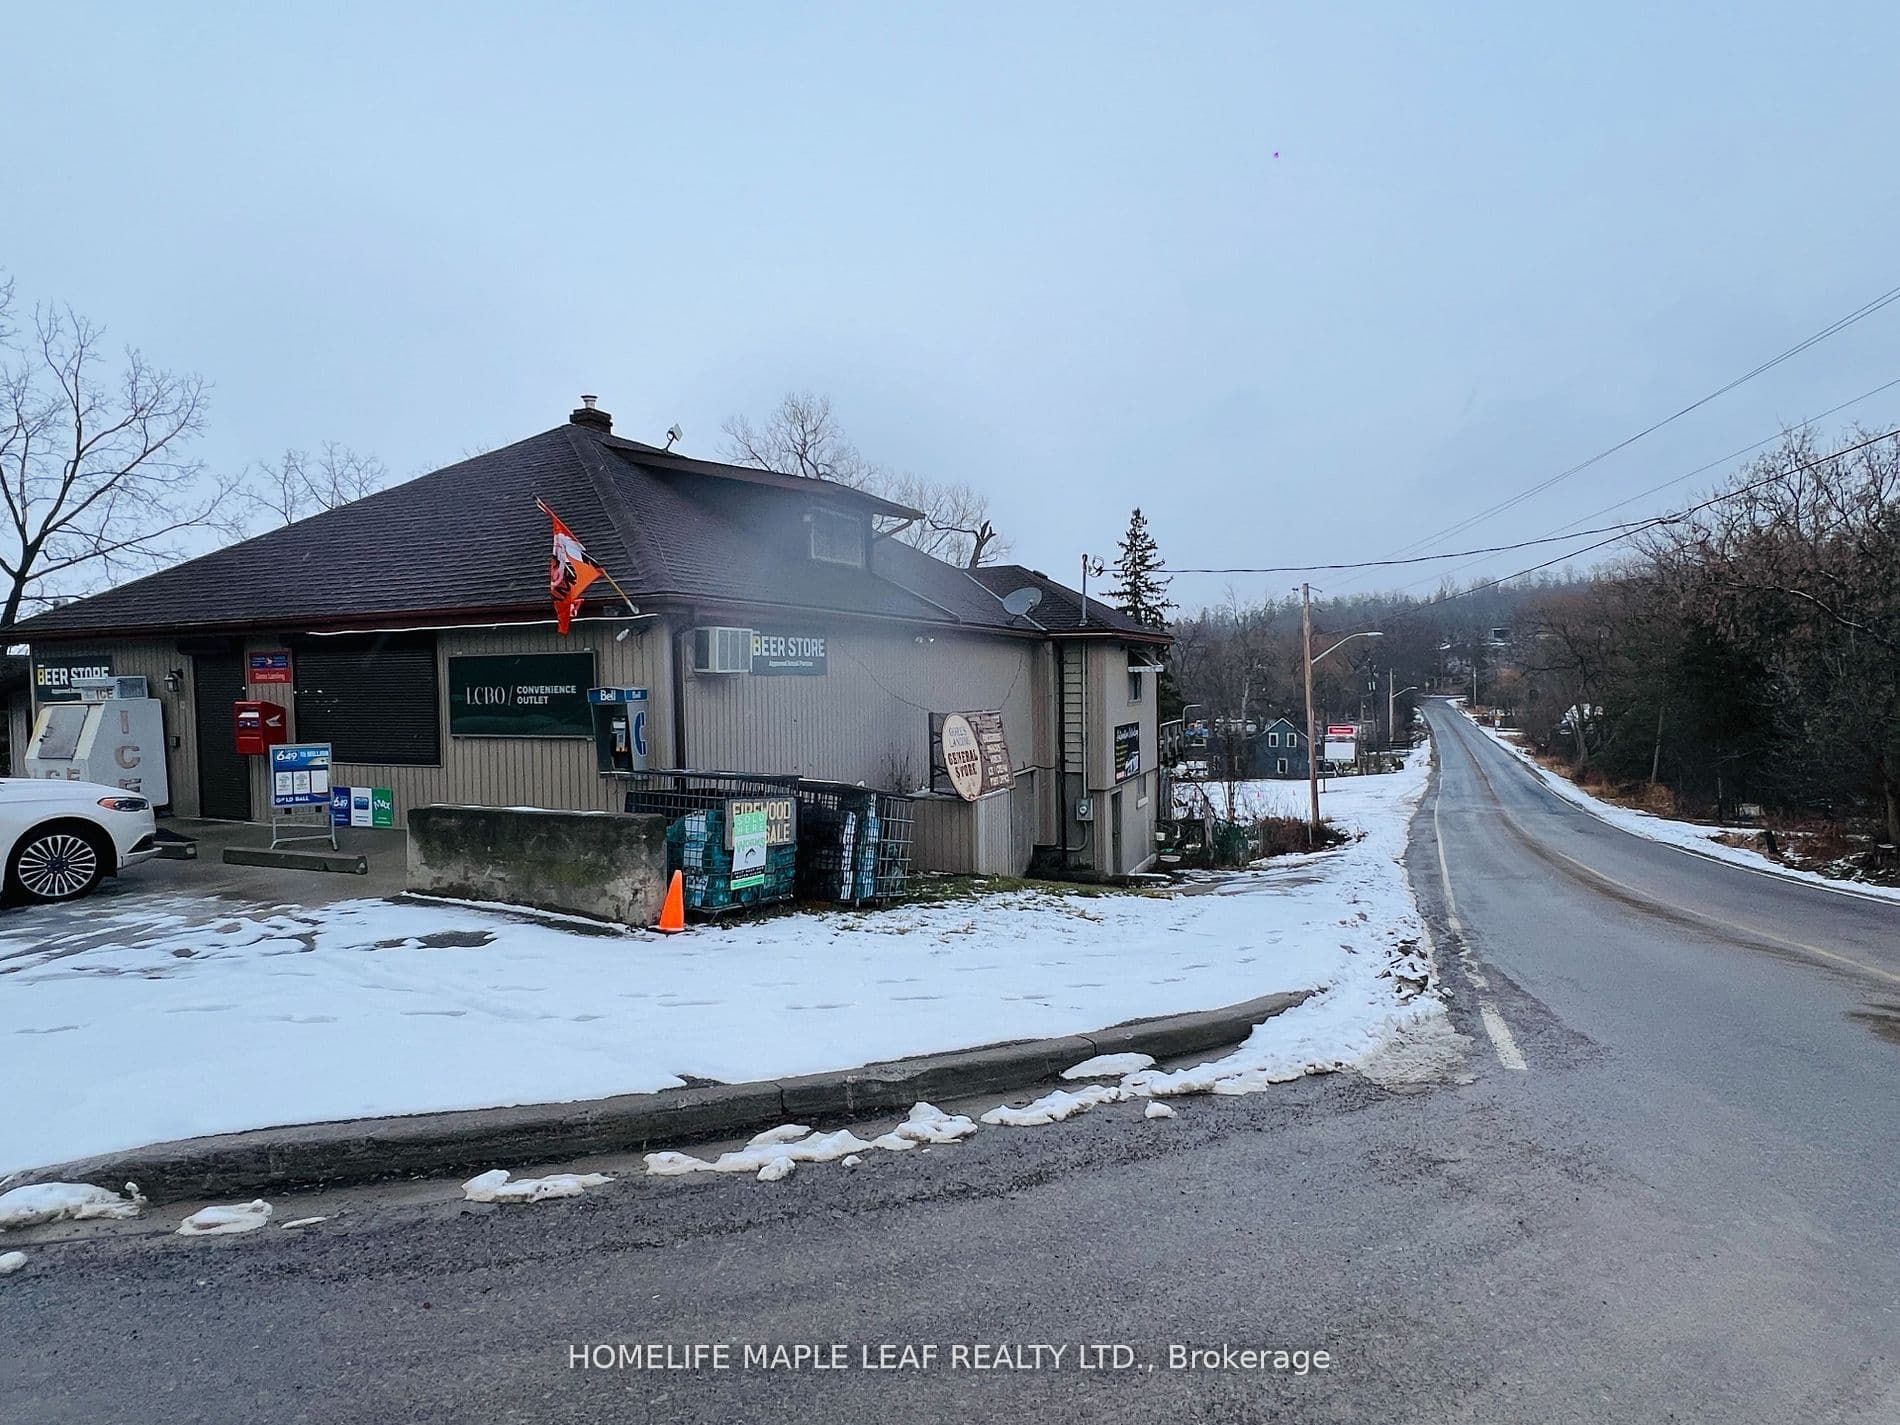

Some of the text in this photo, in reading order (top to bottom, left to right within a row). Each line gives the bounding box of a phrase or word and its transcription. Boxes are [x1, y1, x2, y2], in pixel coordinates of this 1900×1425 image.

[753, 635, 825, 657] BEER STORE
[37, 666, 109, 686] BEER STORE
[95, 688, 113, 700] ICE
[466, 686, 506, 705] LCBO
[516, 685, 577, 694] CONVENIENCE
[600, 690, 616, 701] Bell
[516, 696, 549, 705] OUTLET
[947, 749, 978, 766] GENERAL
[955, 763, 978, 779] STORE
[732, 801, 791, 820] FIREWOOD
